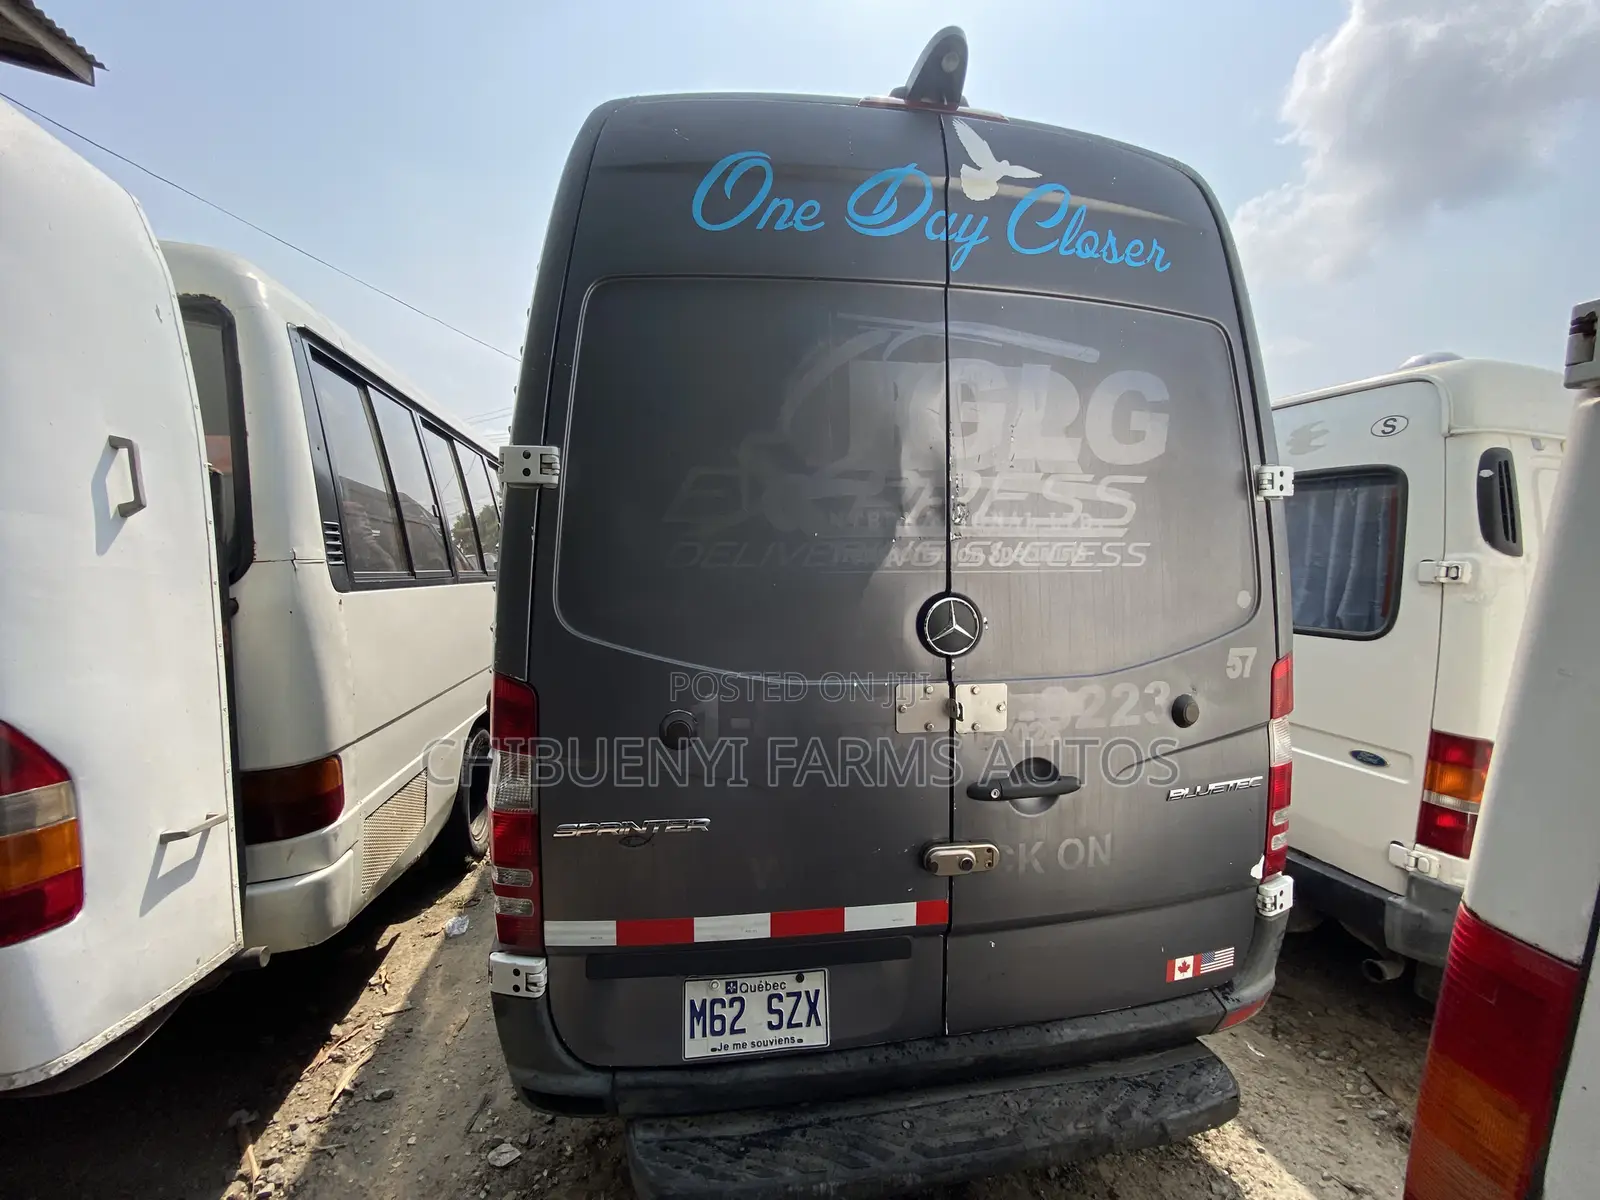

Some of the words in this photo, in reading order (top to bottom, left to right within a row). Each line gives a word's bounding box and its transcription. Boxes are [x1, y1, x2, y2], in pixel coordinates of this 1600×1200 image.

[692, 150, 825, 232] One
[845, 162, 989, 272] Day
[1007, 182, 1172, 272] Closer
[1381, 416, 1398, 436] S
[662, 466, 1148, 526] EPRESS
[1225, 647, 1258, 680] 57
[1166, 775, 1263, 802] BLUETEC
[553, 817, 712, 838] SPRINTER
[1058, 832, 1112, 871] ON
[739, 980, 787, 994] Québec
[689, 996, 747, 1040] M62
[767, 988, 822, 1031] SZX
[718, 1042, 730, 1052] Je
[733, 1041, 748, 1050] me
[751, 1036, 796, 1049] souviens
